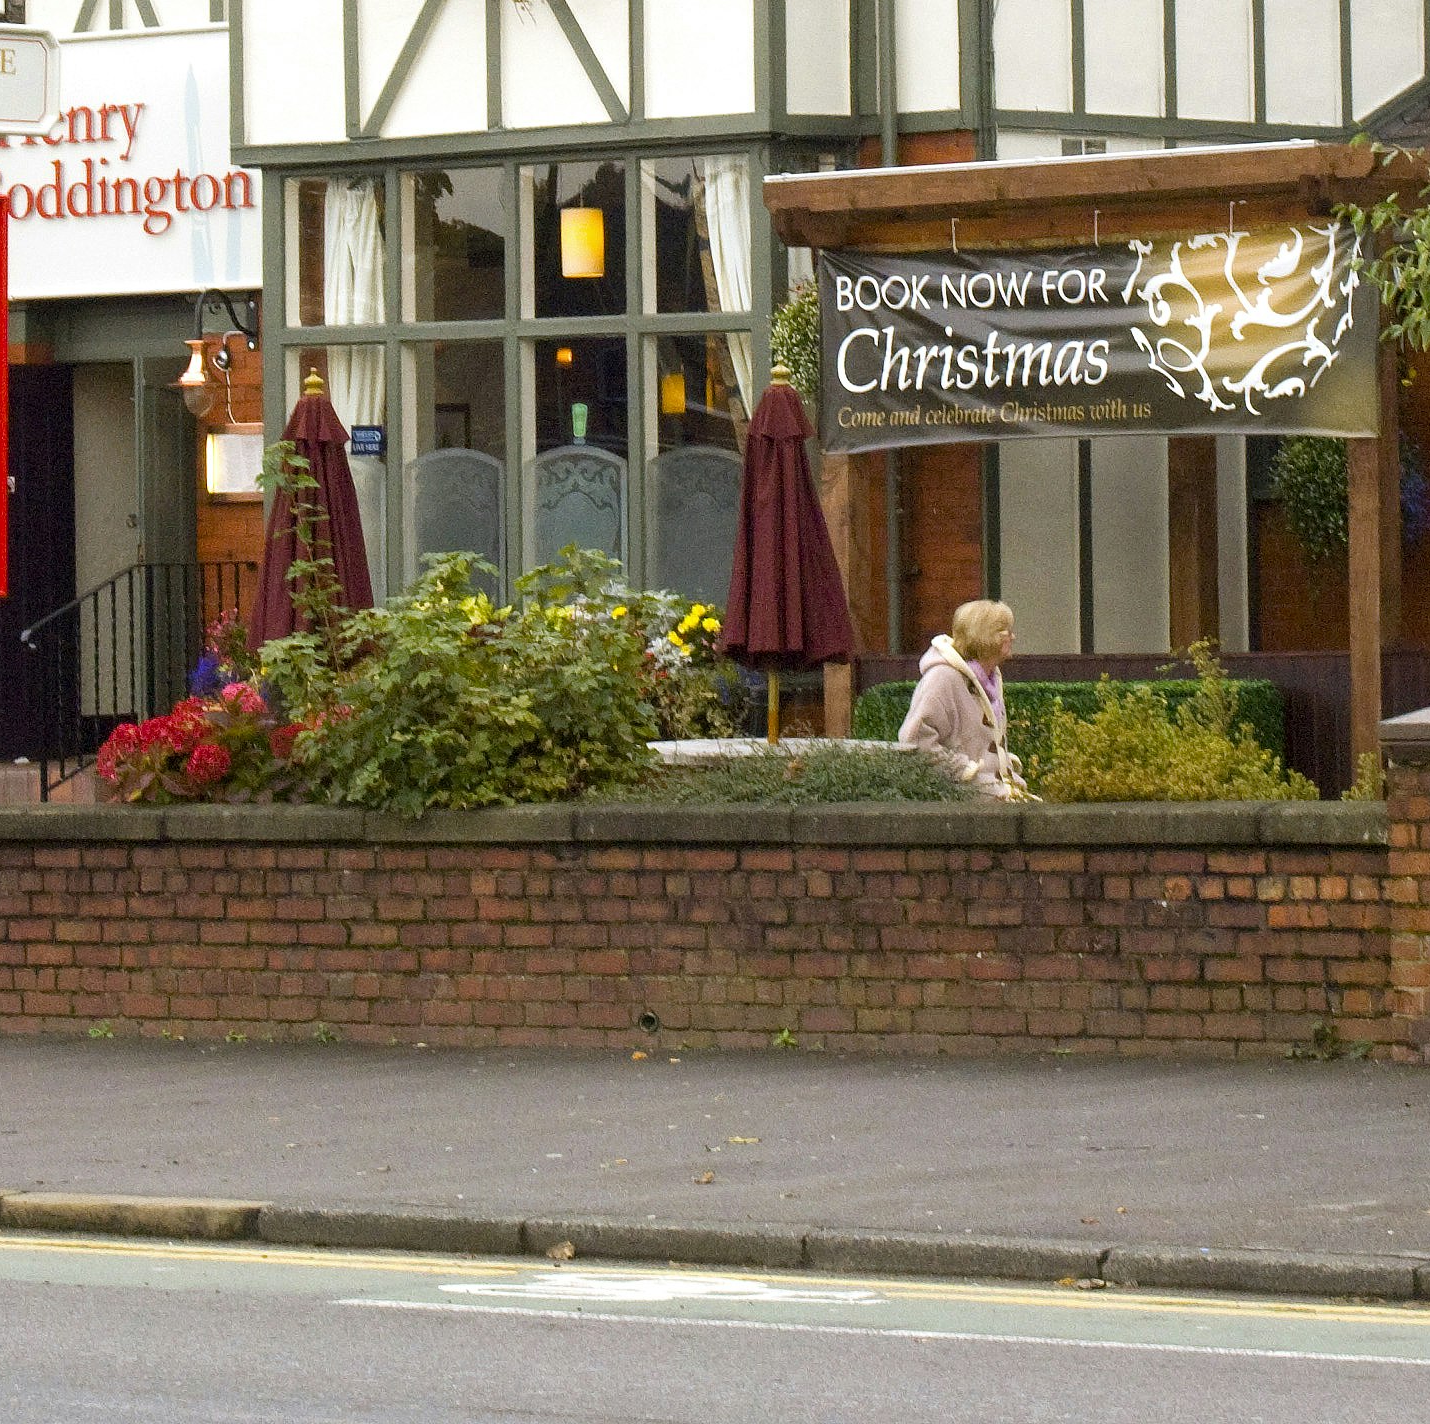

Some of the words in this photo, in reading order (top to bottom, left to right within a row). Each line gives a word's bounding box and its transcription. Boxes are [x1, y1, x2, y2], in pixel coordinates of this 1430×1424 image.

[836, 275, 931, 311] BOOK
[941, 271, 1033, 309] NOW
[1042, 269, 1109, 306] FOR
[837, 326, 1110, 393] Christmas
[838, 407, 884, 428] Come
[889, 407, 919, 426] and
[925, 404, 996, 426] celebrate
[1000, 401, 1085, 424] Christmas
[1089, 399, 1127, 420] with
[1133, 401, 1151, 419] us
